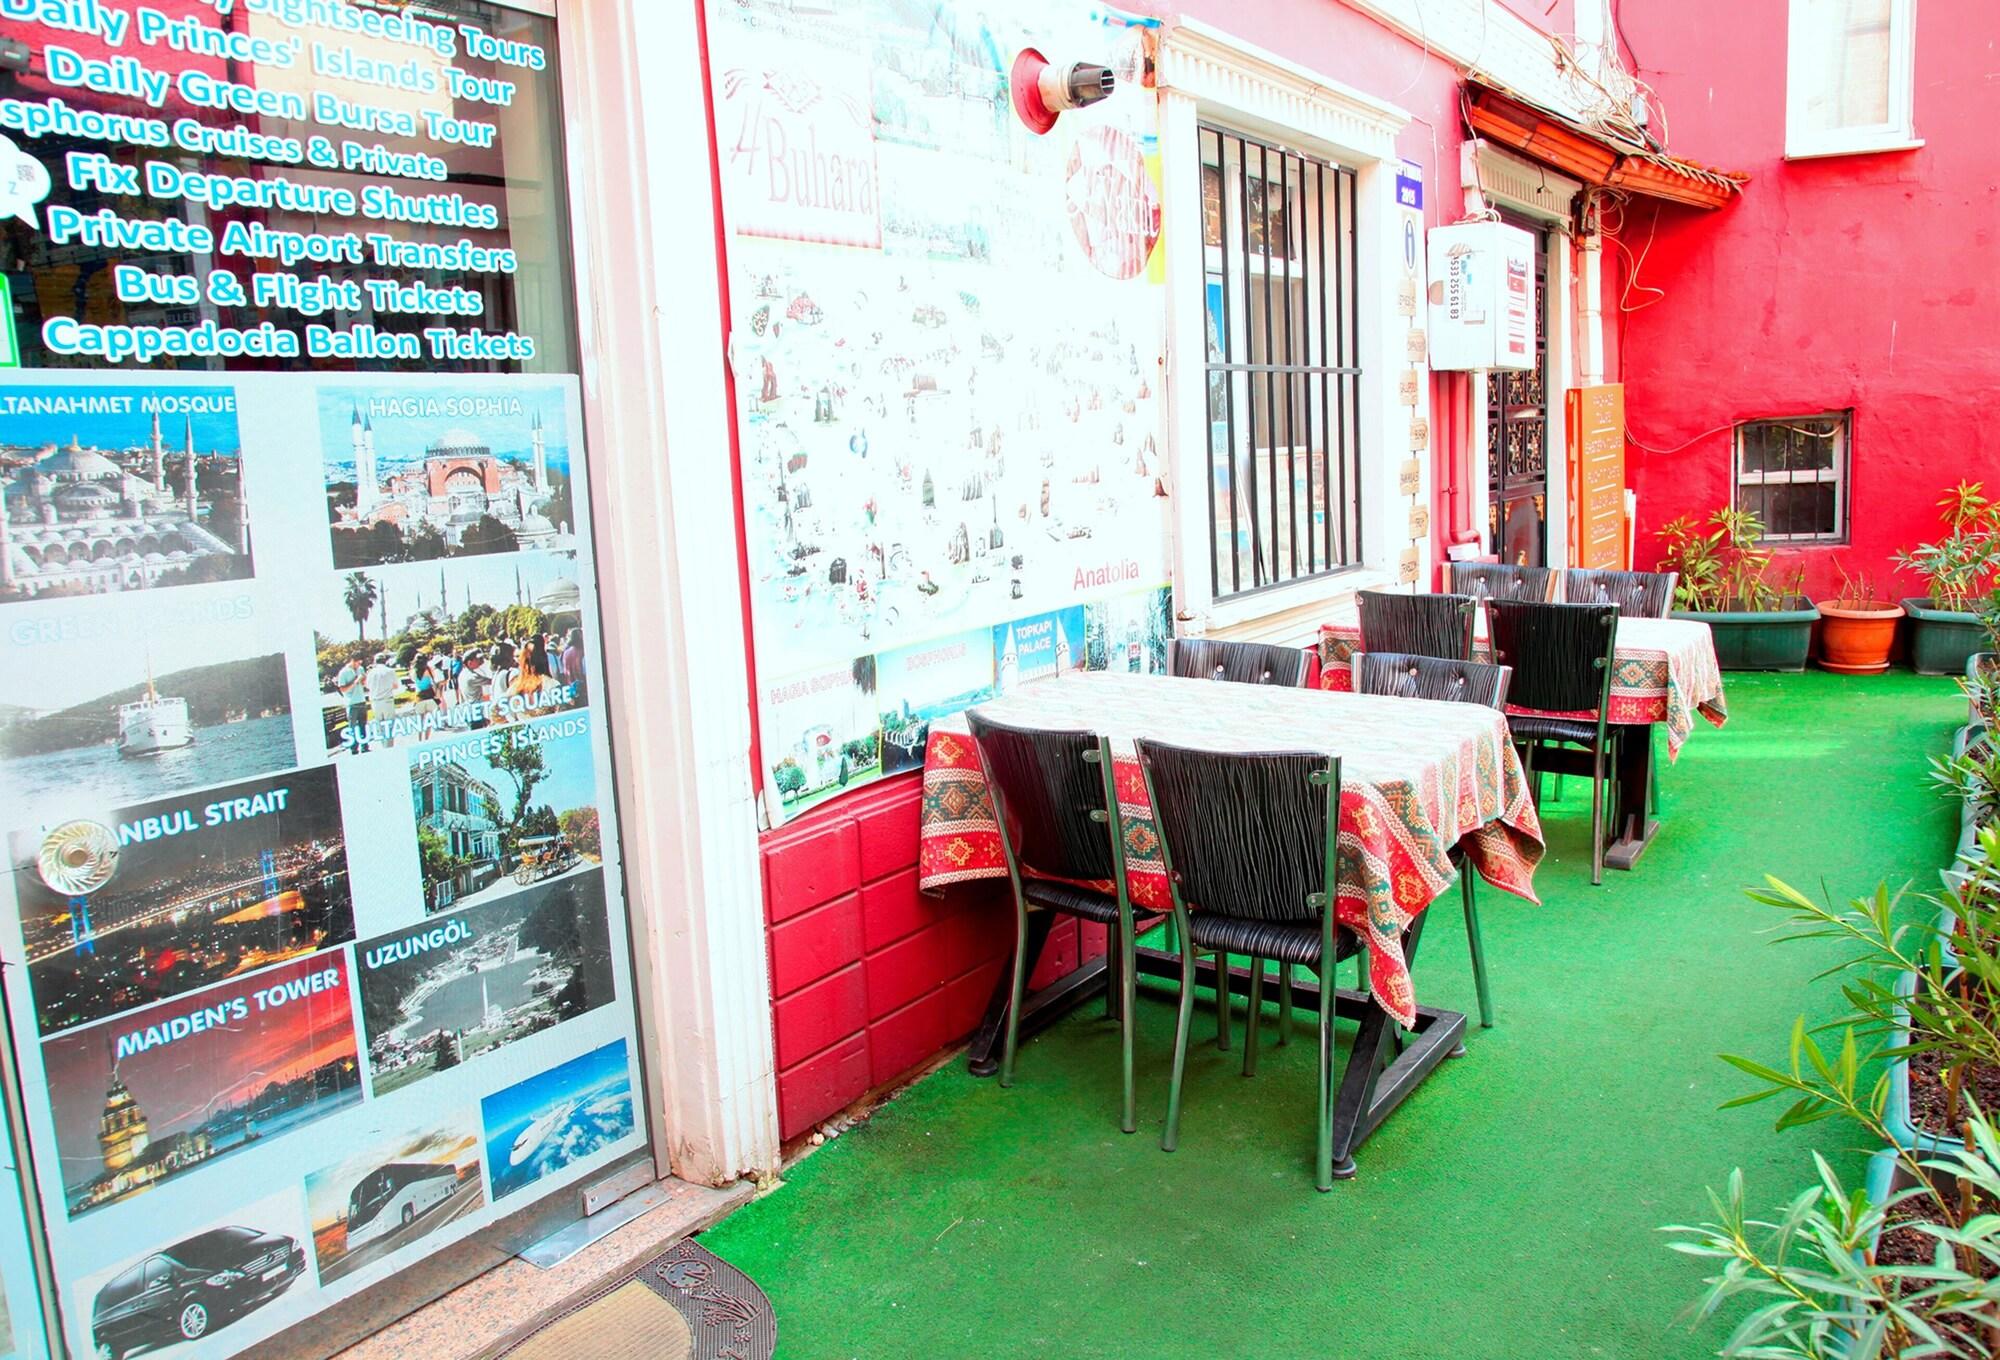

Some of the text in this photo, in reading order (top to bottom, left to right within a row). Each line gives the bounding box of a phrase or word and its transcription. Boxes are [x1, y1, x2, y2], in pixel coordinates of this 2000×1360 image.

[1, 0, 515, 104] Daily Princes' Islands Tour
[462, 26, 544, 69] Tours
[47, 46, 496, 147] Daily Green Bursa Tour
[175, 119, 300, 164] Cruises
[307, 137, 336, 168] &
[343, 143, 449, 180] Private
[763, 114, 874, 216] Buhara
[67, 152, 498, 230] Fix Departure Shuttles
[49, 206, 517, 274] Private Airport Transfers
[116, 266, 483, 316] Bus & Flight Tickets
[1450, 278, 1460, 294] 255
[1450, 296, 1460, 307] 61
[1450, 308, 1460, 320] 83
[43, 318, 535, 362] Cappadocia Ballon Tickets
[141, 396, 235, 415] MOSQUE
[368, 396, 524, 418] HAGIA SOPHIA
[1073, 561, 1139, 590] Anatolia
[1016, 620, 1053, 641] TOPKAPI
[1018, 637, 1052, 655] PALACE
[340, 685, 571, 749] SULTANAHMET SQUARE
[419, 717, 588, 769] PRINCES' ISLANDS
[204, 788, 288, 826] STRAIT
[366, 919, 472, 969] UZUNGÖL
[117, 968, 340, 1058] MAIDEN'S TOWER
